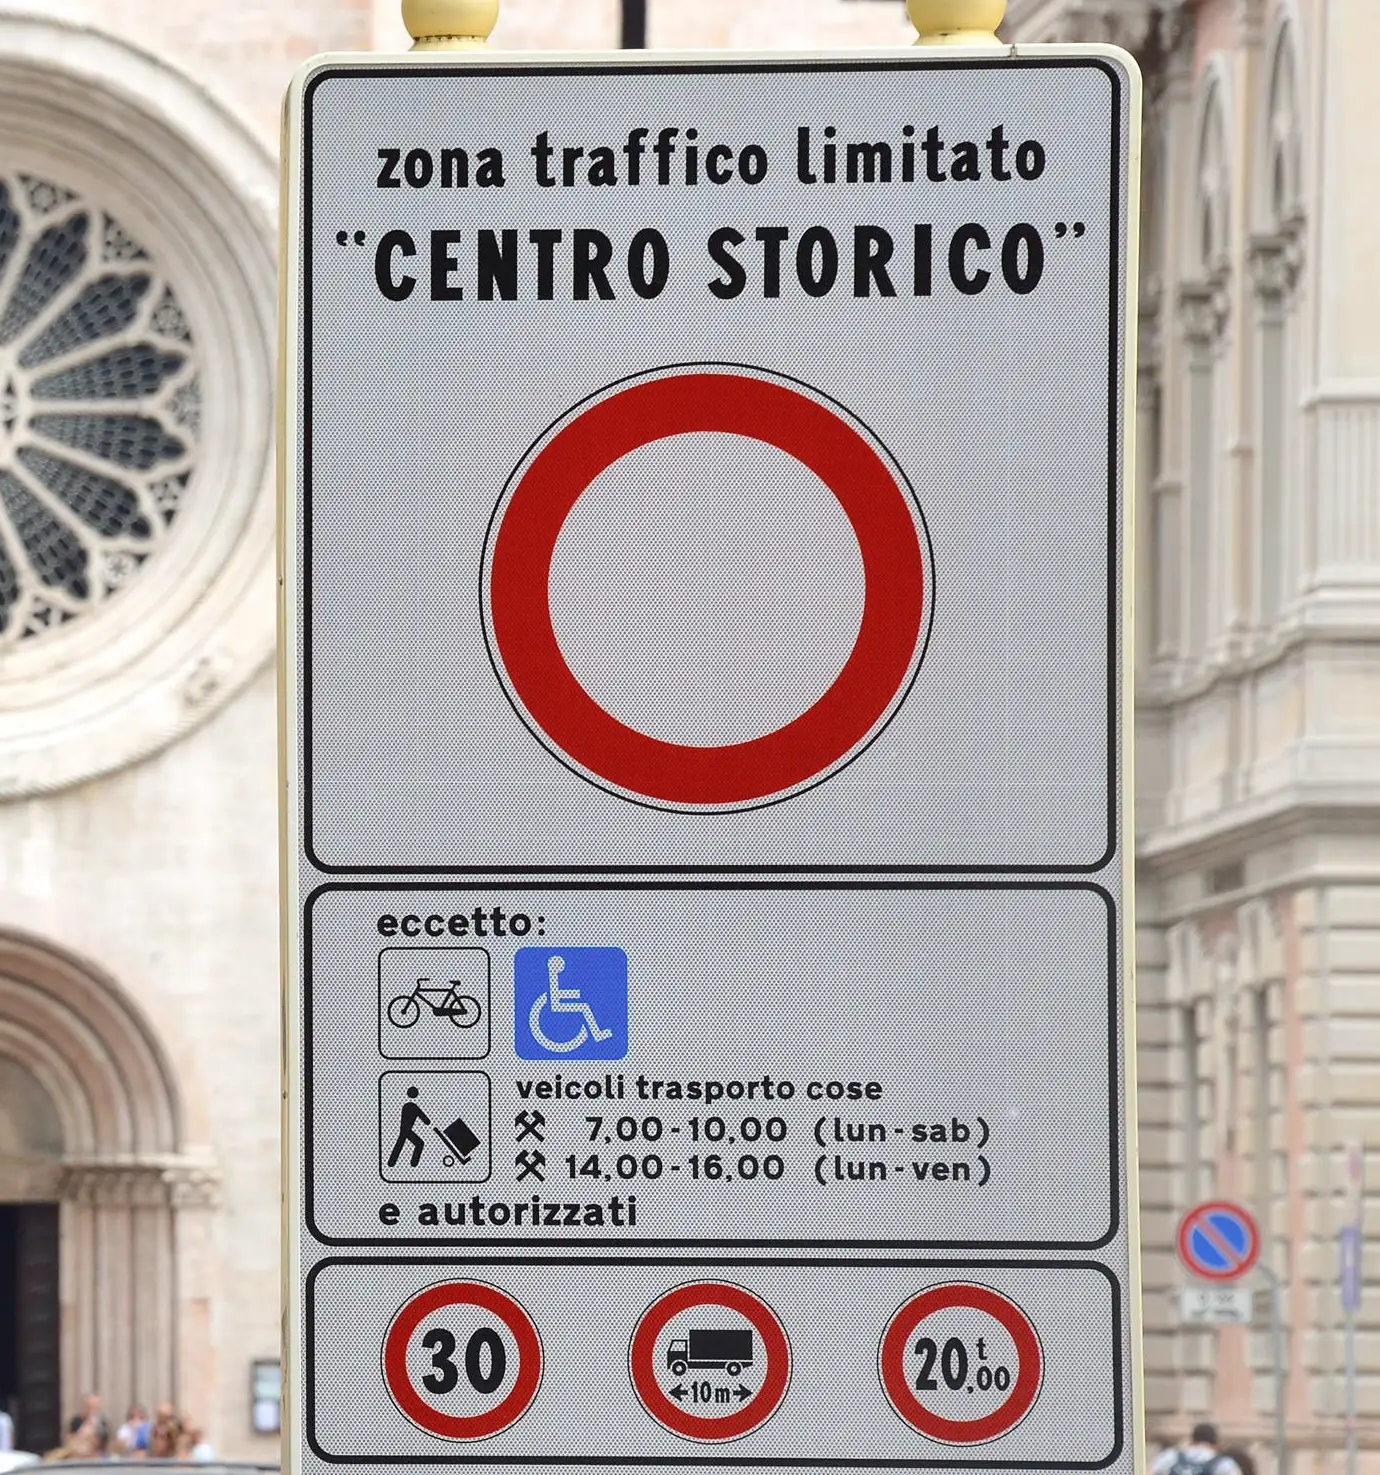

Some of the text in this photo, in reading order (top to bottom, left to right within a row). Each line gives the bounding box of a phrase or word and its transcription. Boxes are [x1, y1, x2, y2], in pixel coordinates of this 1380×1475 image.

[376, 125, 1047, 189] zona traffico limitato
[376, 906, 548, 938] eccetto:
[515, 1075, 883, 1105] veicoli trasporto cose
[378, 1195, 637, 1227] e autorizzati
[421, 1326, 507, 1395] 30
